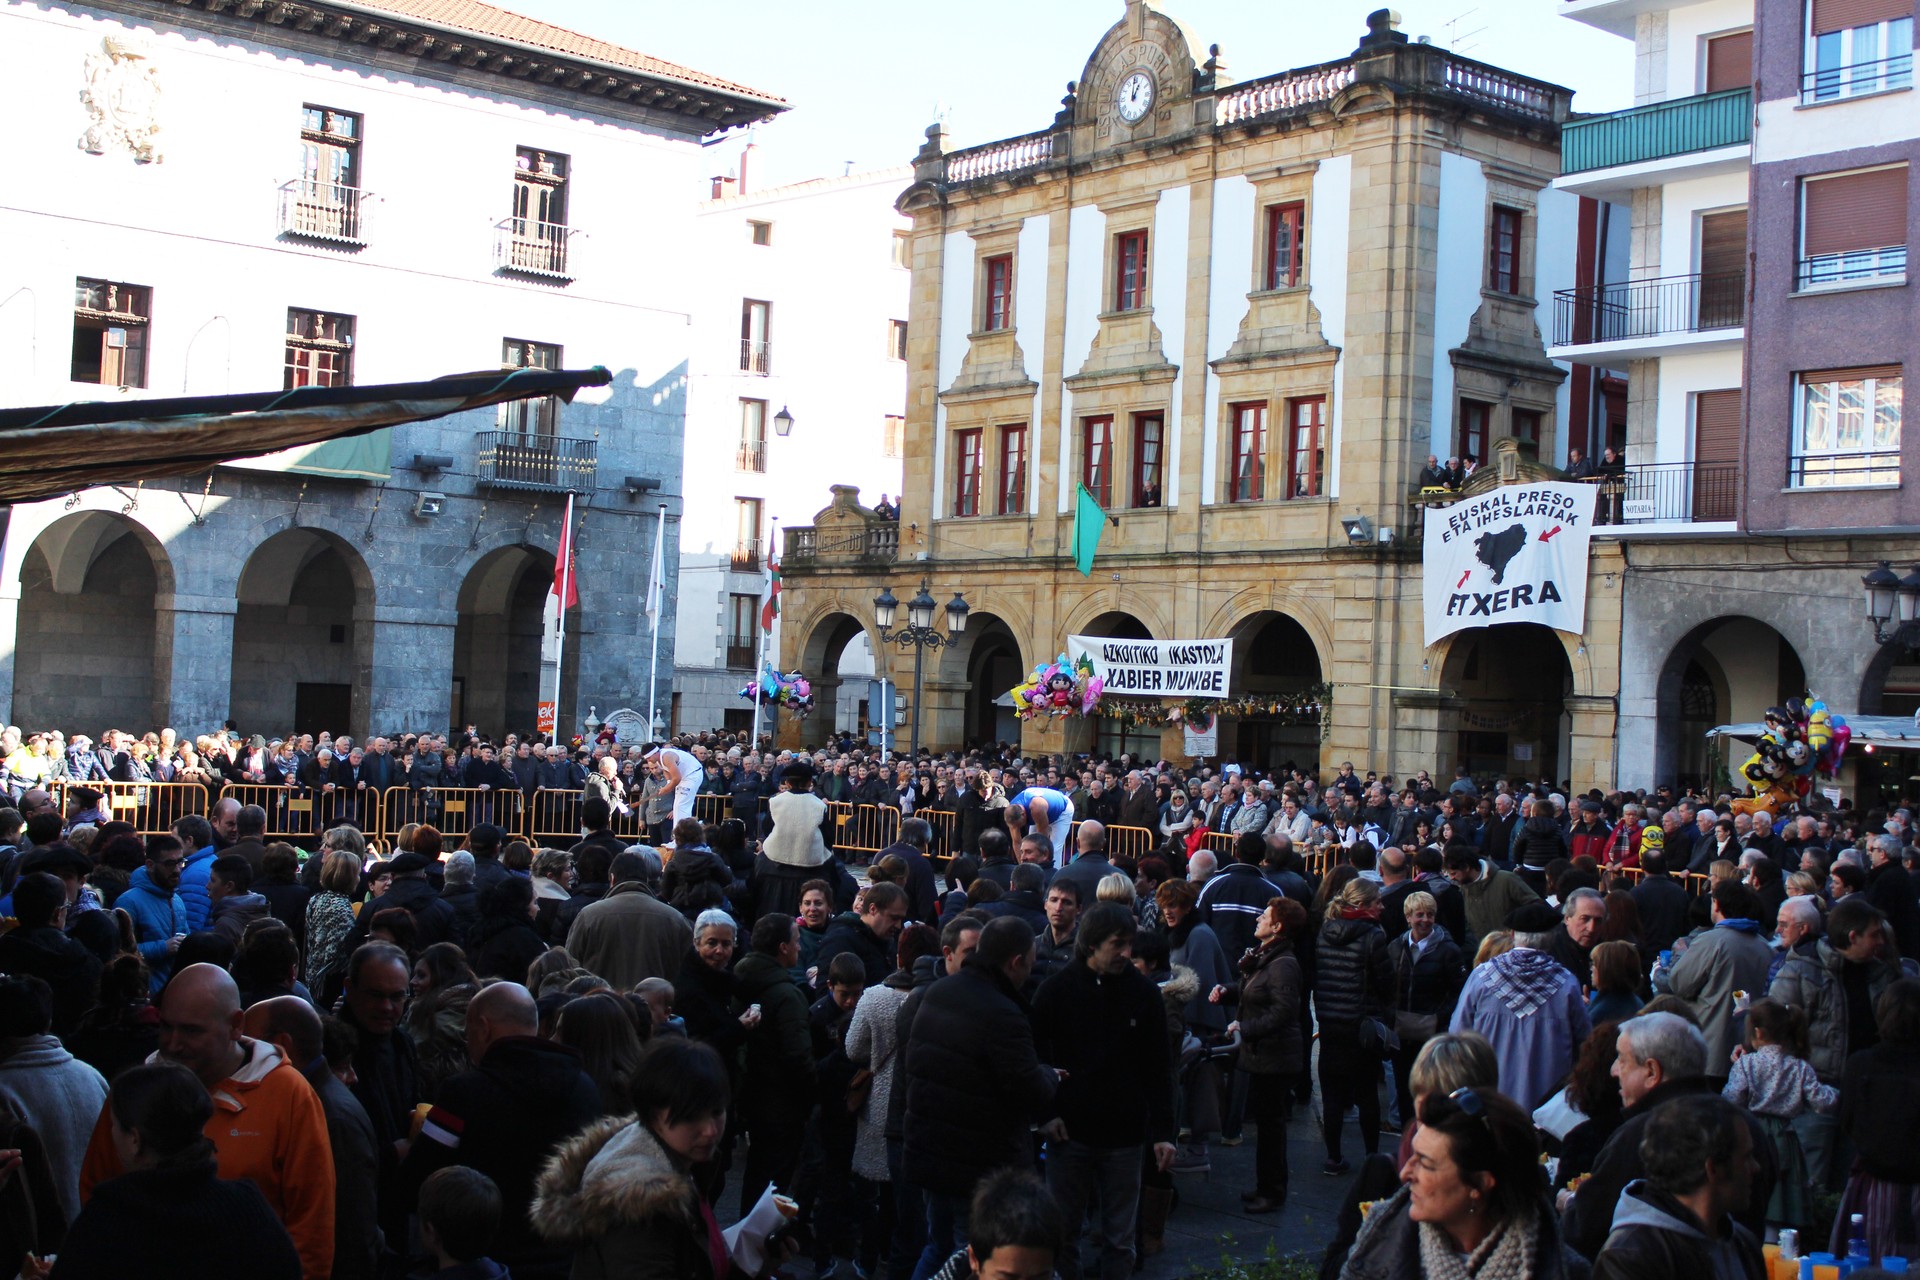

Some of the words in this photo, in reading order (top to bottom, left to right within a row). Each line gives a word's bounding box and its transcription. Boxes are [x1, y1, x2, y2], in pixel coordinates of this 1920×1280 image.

[1448, 493, 1510, 529] EUSKAL
[1517, 490, 1575, 508] PRESO
[1625, 504, 1652, 514] NOTARIA
[1442, 521, 1472, 543] ETA
[1476, 505, 1579, 528] IHESLARIAK
[816, 534, 862, 552] MERCADO
[1446, 580, 1562, 616] ETXERA
[1103, 644, 1159, 664] AZKOITIKO
[1169, 645, 1225, 664] IKASTOLA
[1105, 668, 1162, 690] XABIER
[1165, 671, 1223, 691] MUNIBE
